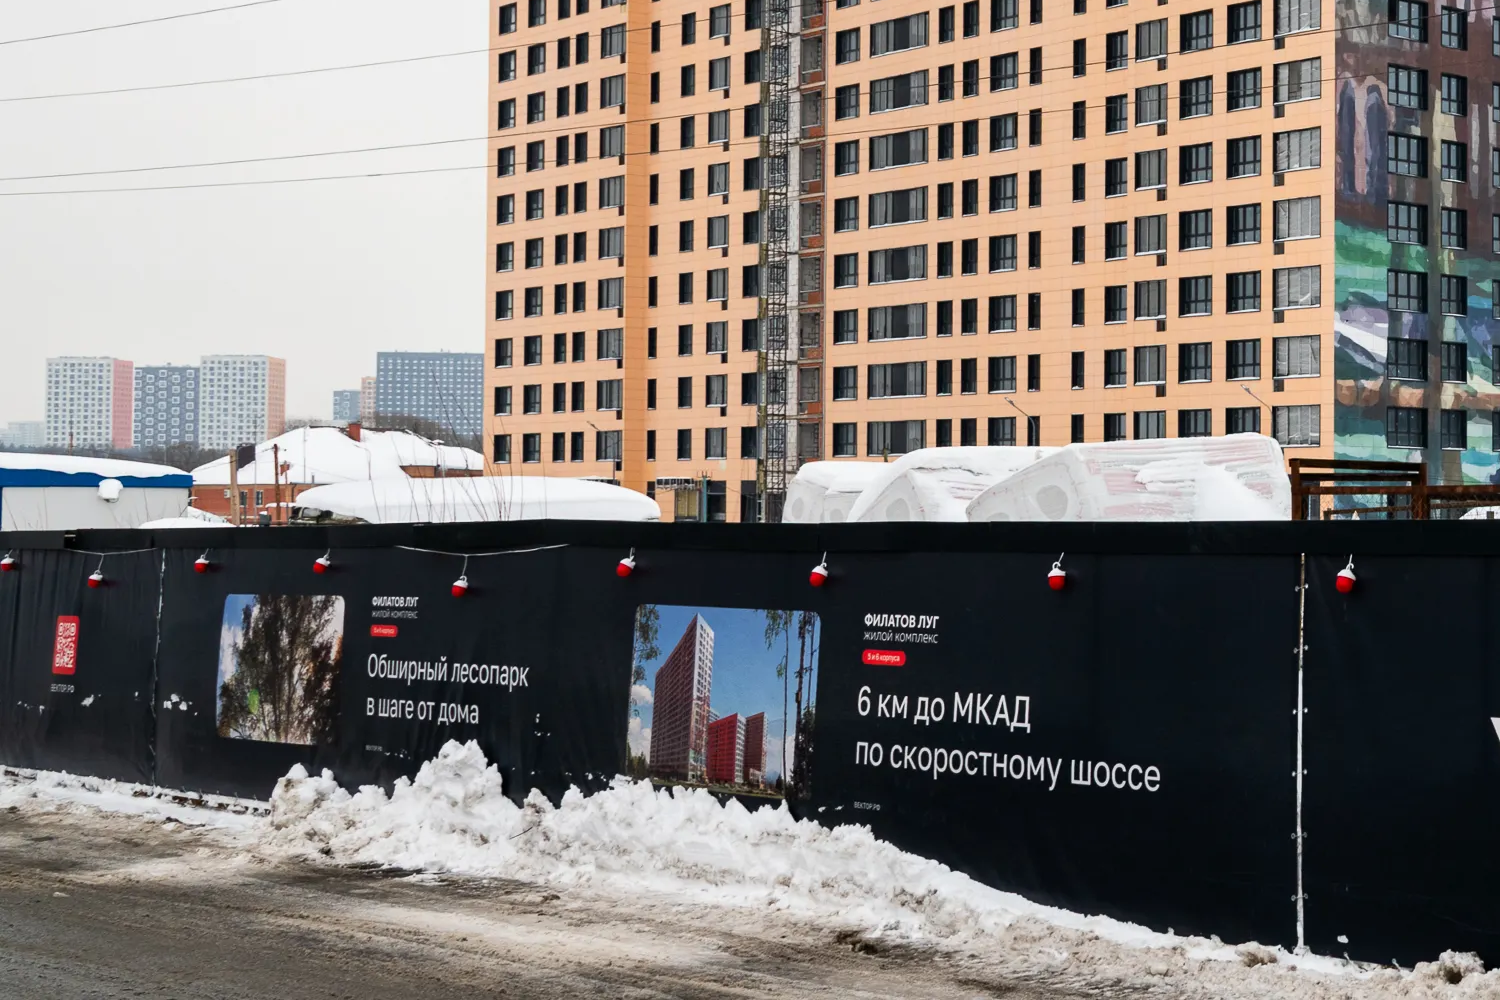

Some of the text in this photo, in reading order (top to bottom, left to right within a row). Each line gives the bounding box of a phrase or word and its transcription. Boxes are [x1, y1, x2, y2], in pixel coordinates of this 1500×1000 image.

[372, 596, 419, 607] ФИЛАТОВ ЛУГ
[864, 613, 940, 629] ФИЛАТОВ ЛУГ
[367, 653, 529, 692] Обширный лесопарк
[366, 697, 479, 726] в шаге от дома
[857, 685, 1031, 733] 6 км до МКАД
[855, 741, 1161, 792] по скоростному шоссе
